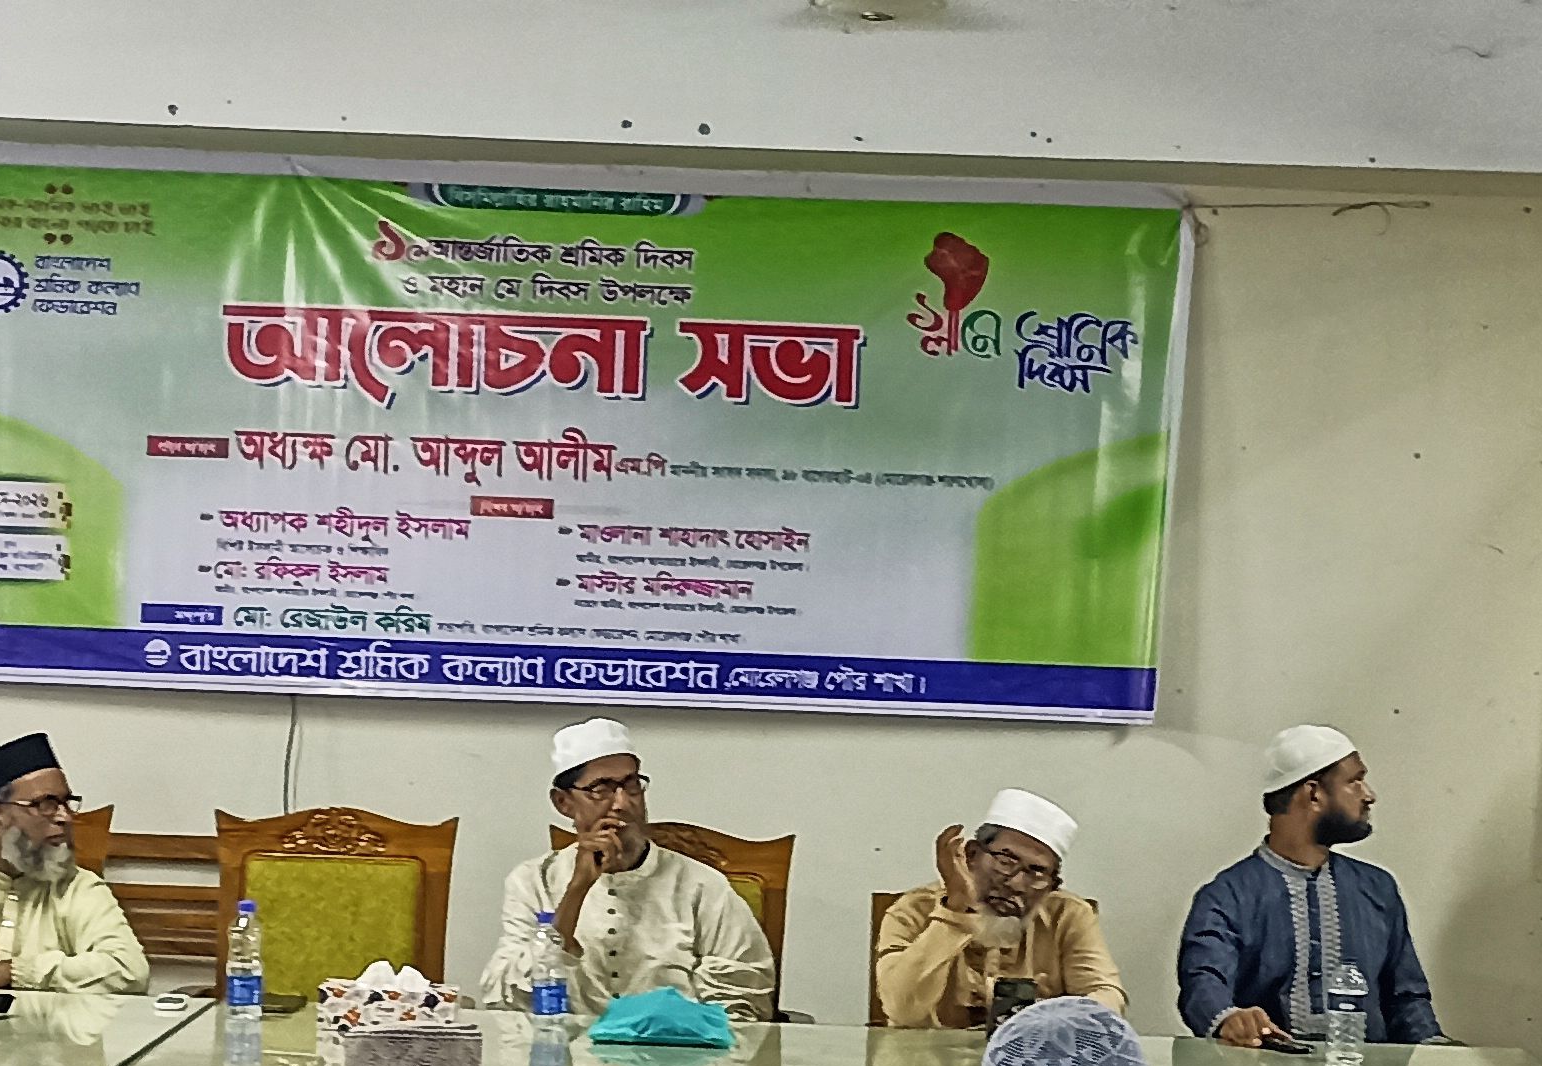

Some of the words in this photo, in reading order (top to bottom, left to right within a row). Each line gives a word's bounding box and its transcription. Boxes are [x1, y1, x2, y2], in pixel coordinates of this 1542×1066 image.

[560, 240, 626, 267] শ্রমিক
[635, 241, 695, 272] দিবস
[494, 278, 523, 299] মে
[531, 273, 590, 302] দিবস
[599, 277, 693, 306] উপলক্ষে
[223, 303, 651, 408] আলোচনা
[678, 319, 864, 408] সভা
[234, 430, 335, 471] অধ্যক্ষ
[345, 433, 400, 475] মো.
[512, 426, 617, 482] আলীম
[218, 509, 308, 533] অধ্যাপক
[395, 509, 472, 540] ইসলাম
[327, 560, 390, 584] ইসলাম
[179, 643, 329, 676] বাংলাদেশ
[337, 641, 431, 680] শ্রমিক
[441, 653, 546, 686] কল্যাণ
[554, 657, 721, 691] ফেডারেশন
